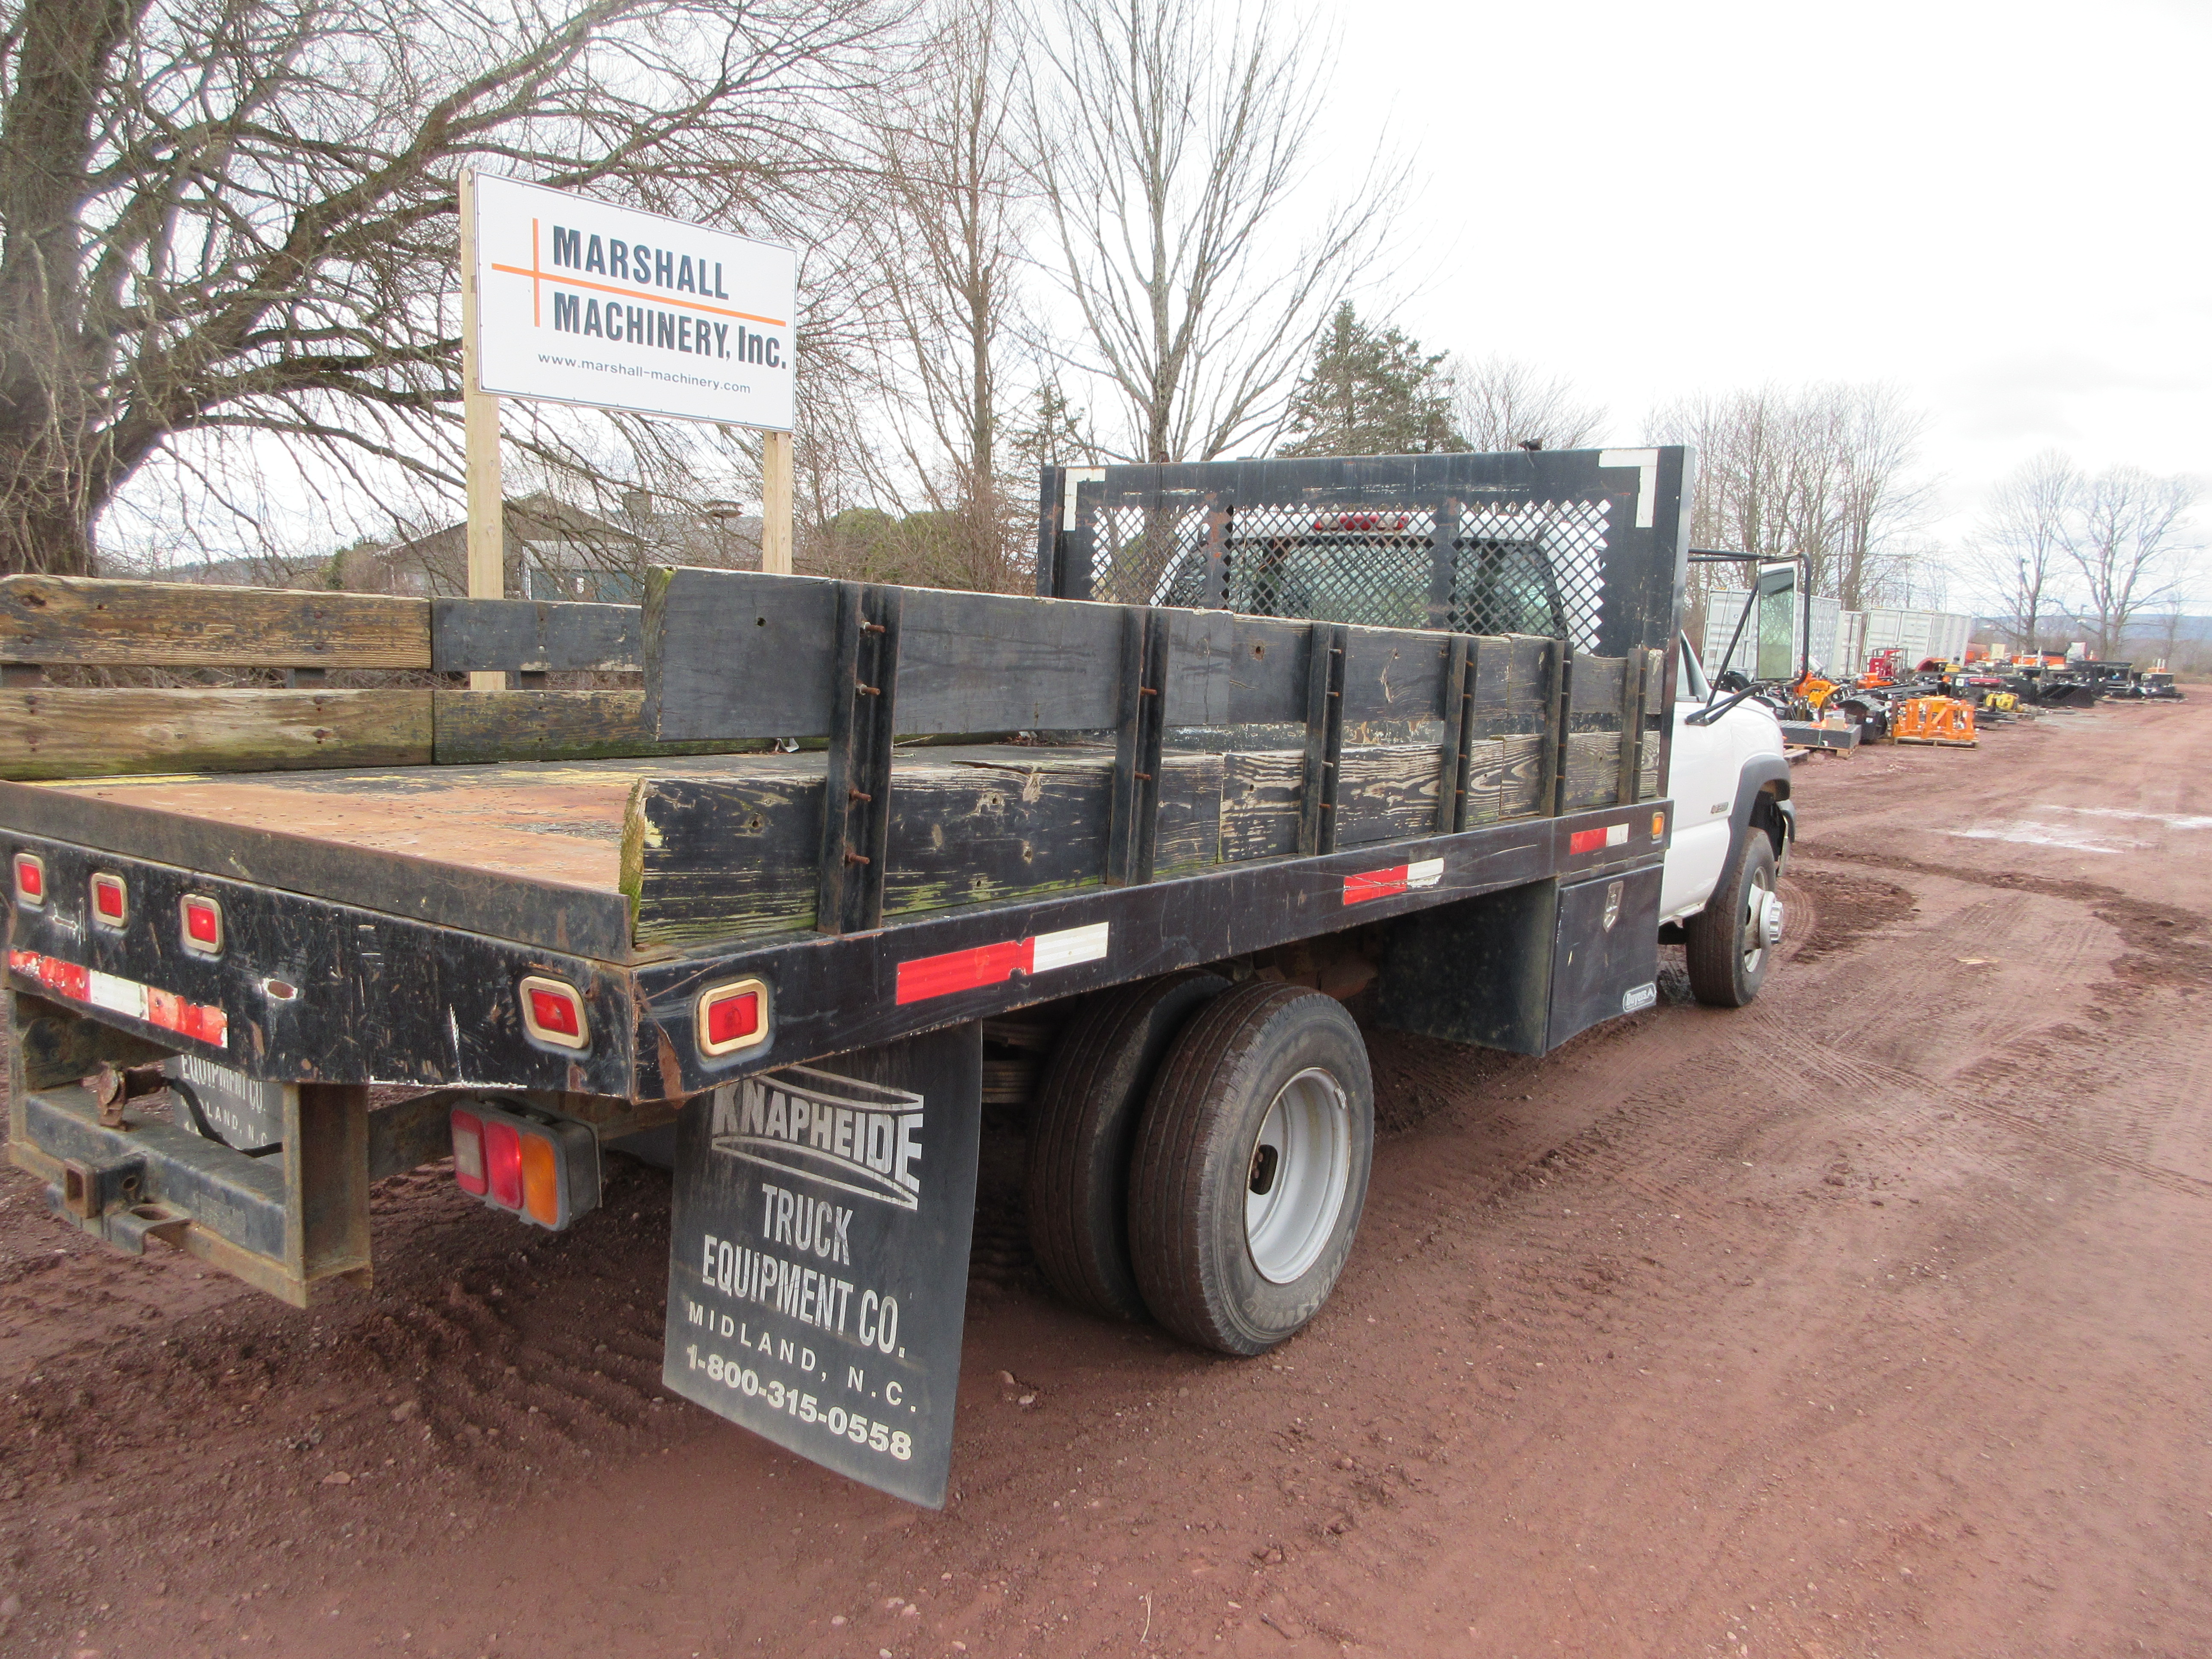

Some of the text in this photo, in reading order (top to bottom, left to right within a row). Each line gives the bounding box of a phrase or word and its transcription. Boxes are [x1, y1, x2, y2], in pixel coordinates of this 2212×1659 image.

[553, 225, 729, 300] MARSHALL
[554, 291, 787, 370] MACHINERY, Inc.
[538, 353, 751, 394] www.marshall-machinery.com
[711, 1075, 923, 1193] KNAPHEIDE
[762, 1183, 853, 1266] TRUCK
[702, 1234, 905, 1358] EQUIPMENT CO.
[688, 1301, 827, 1382] MIDLAND,
[686, 1344, 912, 1460] 1-800-315-0558
